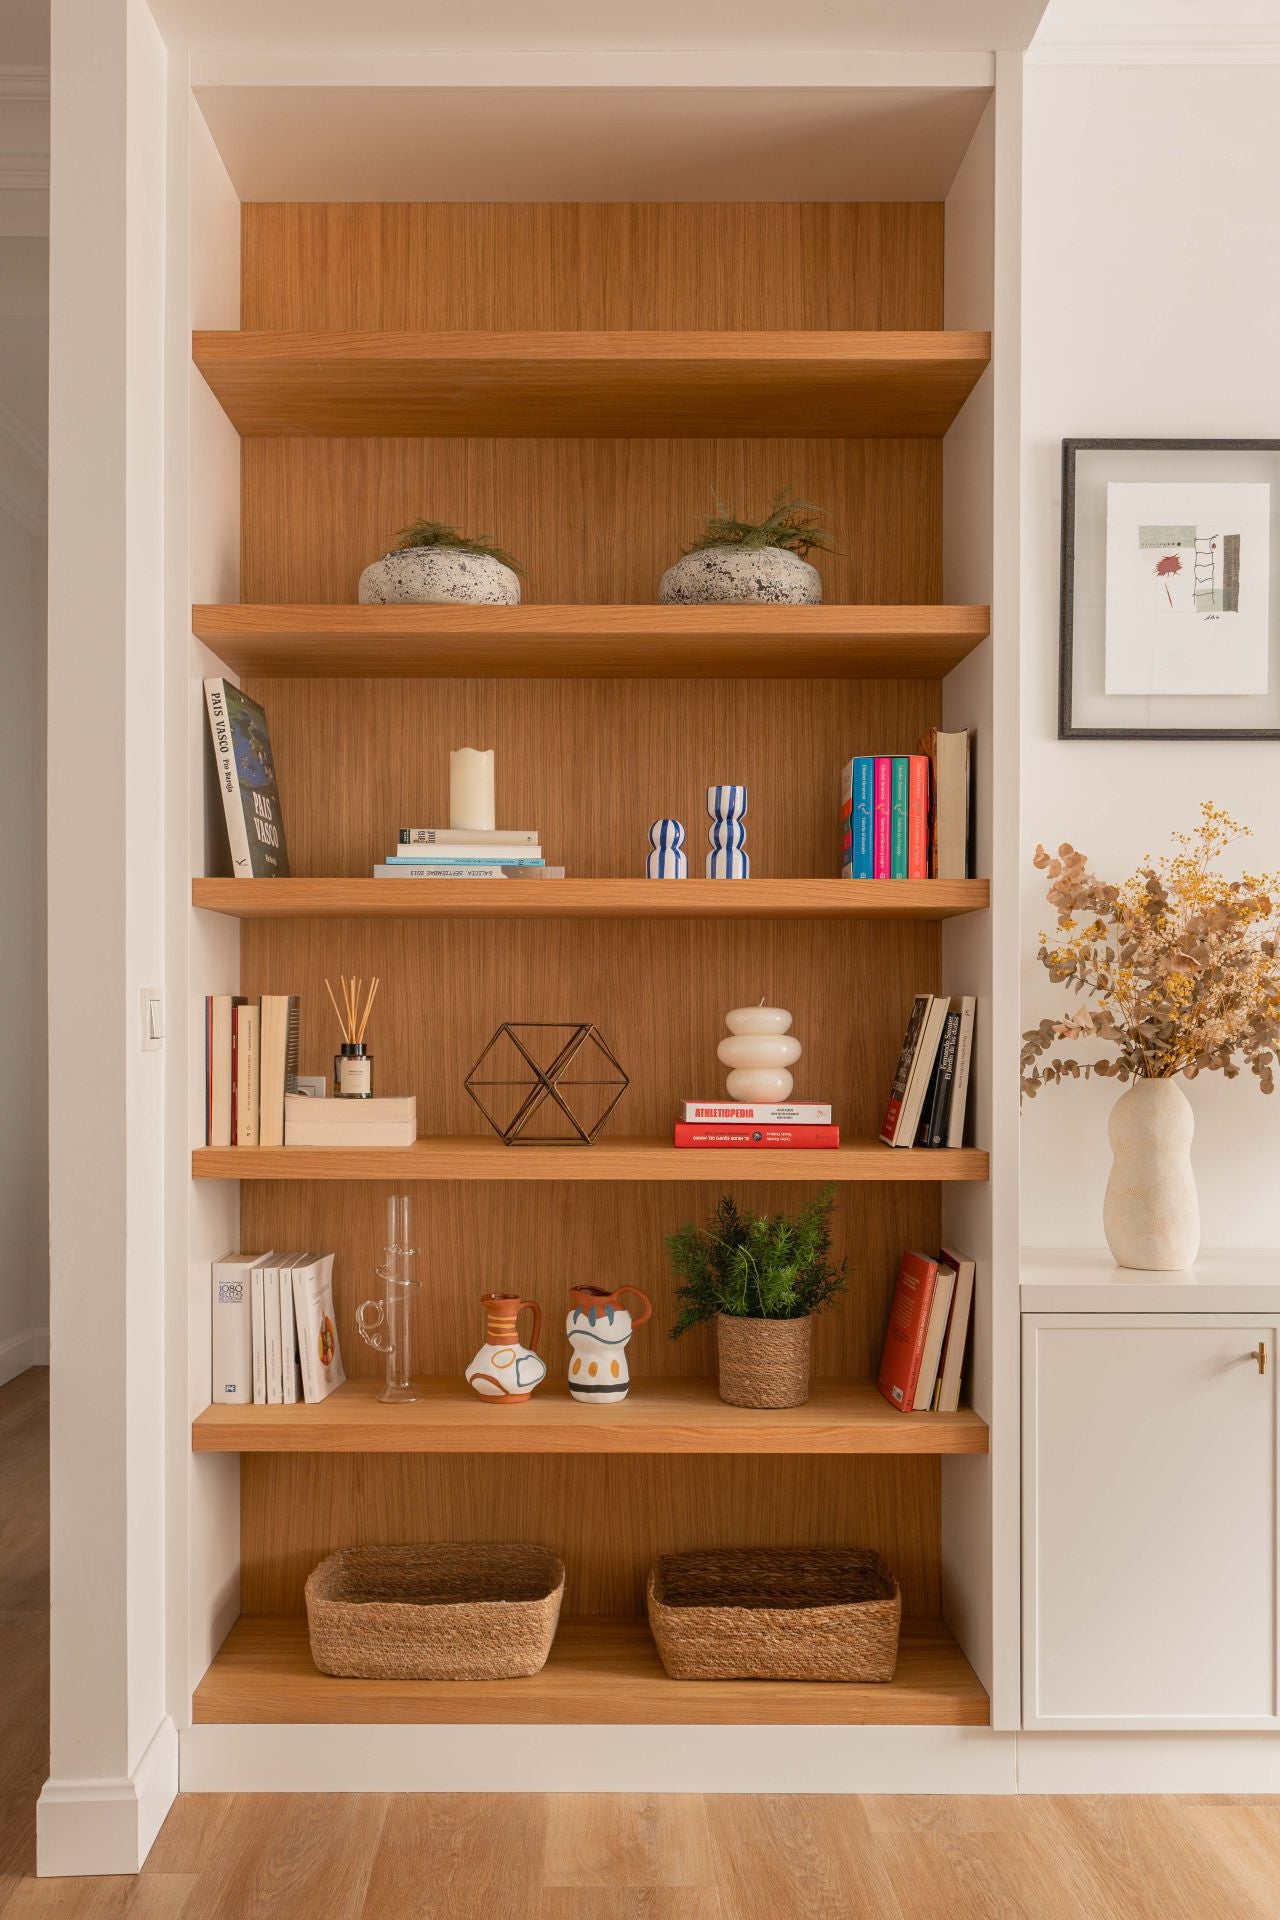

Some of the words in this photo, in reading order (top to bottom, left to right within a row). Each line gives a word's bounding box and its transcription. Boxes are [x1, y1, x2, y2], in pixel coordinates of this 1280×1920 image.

[211, 692, 224, 717] PAIS
[215, 721, 229, 753] VASCO
[225, 771, 234, 793] Baroja
[252, 791, 273, 820] PAIS
[253, 817, 279, 848] VASCO
[945, 1016, 954, 1039] Savater
[941, 1040, 950, 1070] Fernando
[949, 1047, 955, 1056] de
